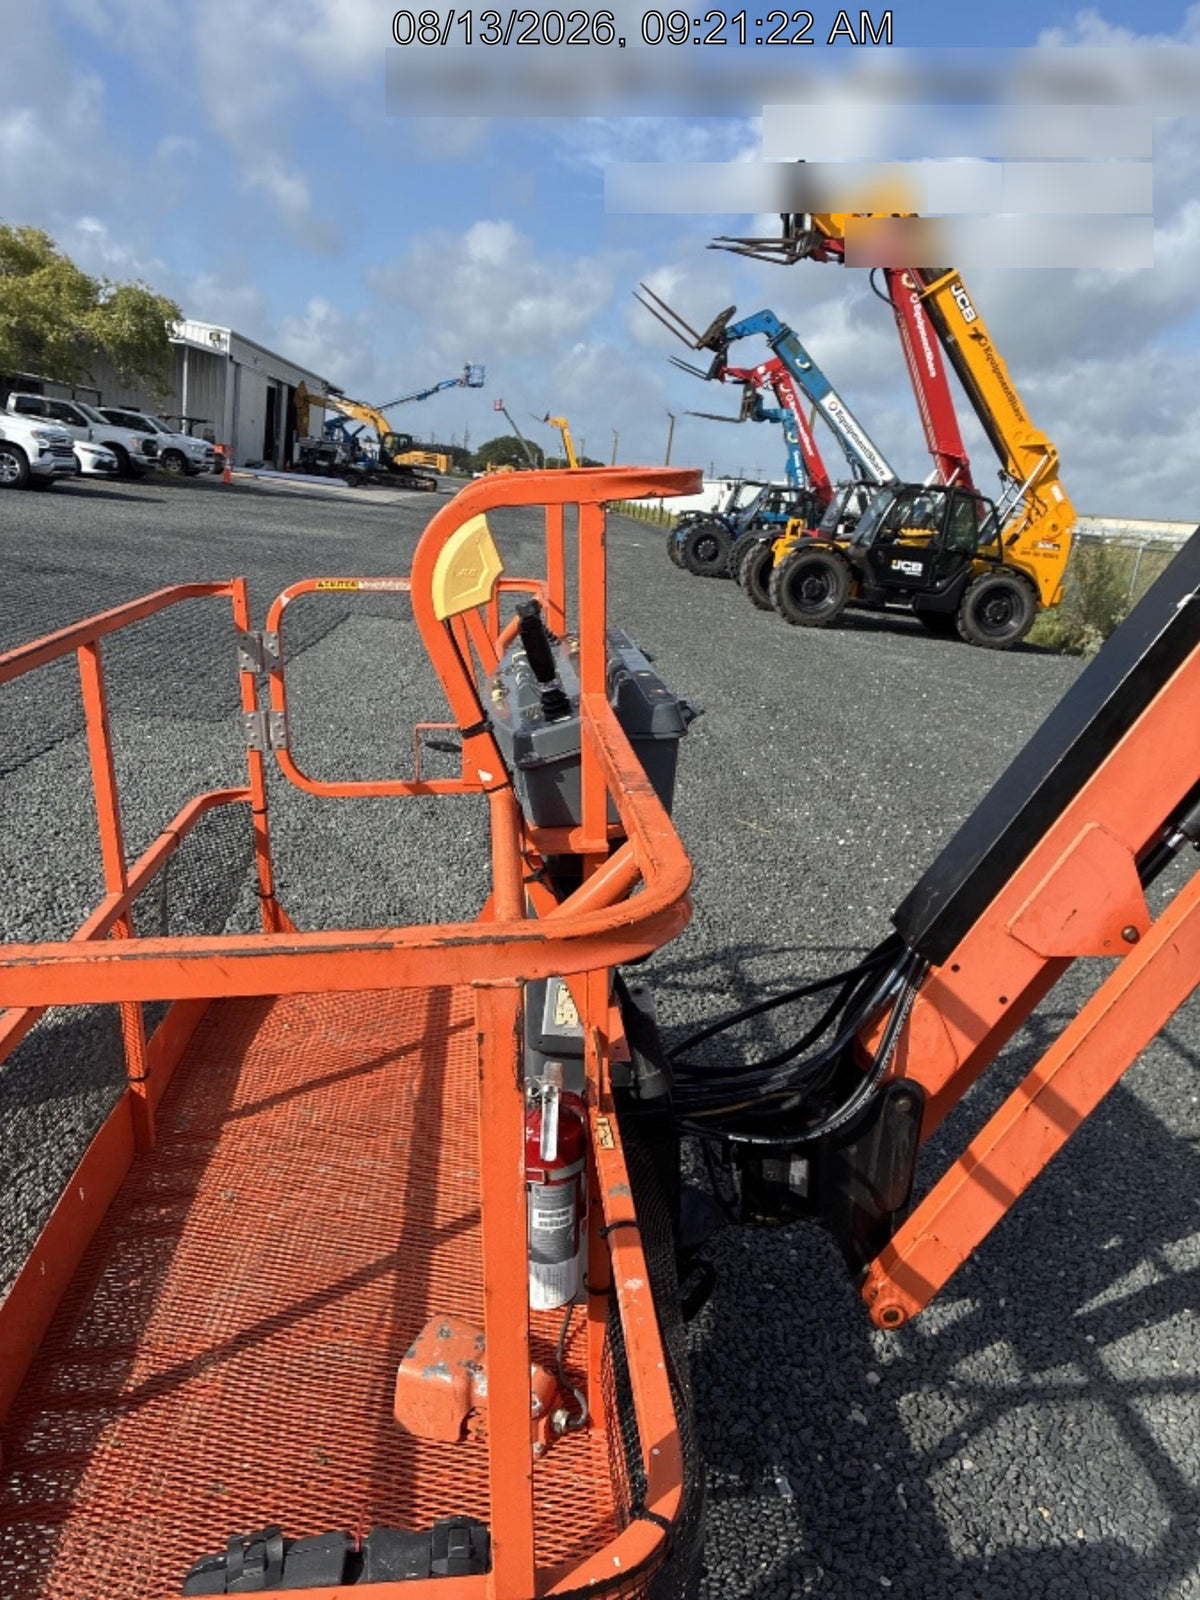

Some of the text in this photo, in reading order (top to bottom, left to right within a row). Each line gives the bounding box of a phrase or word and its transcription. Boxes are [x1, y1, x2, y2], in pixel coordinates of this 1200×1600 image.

[951, 283, 976, 323] JCB
[834, 409, 886, 477] EquipmentShare
[890, 559, 924, 572] JCB
